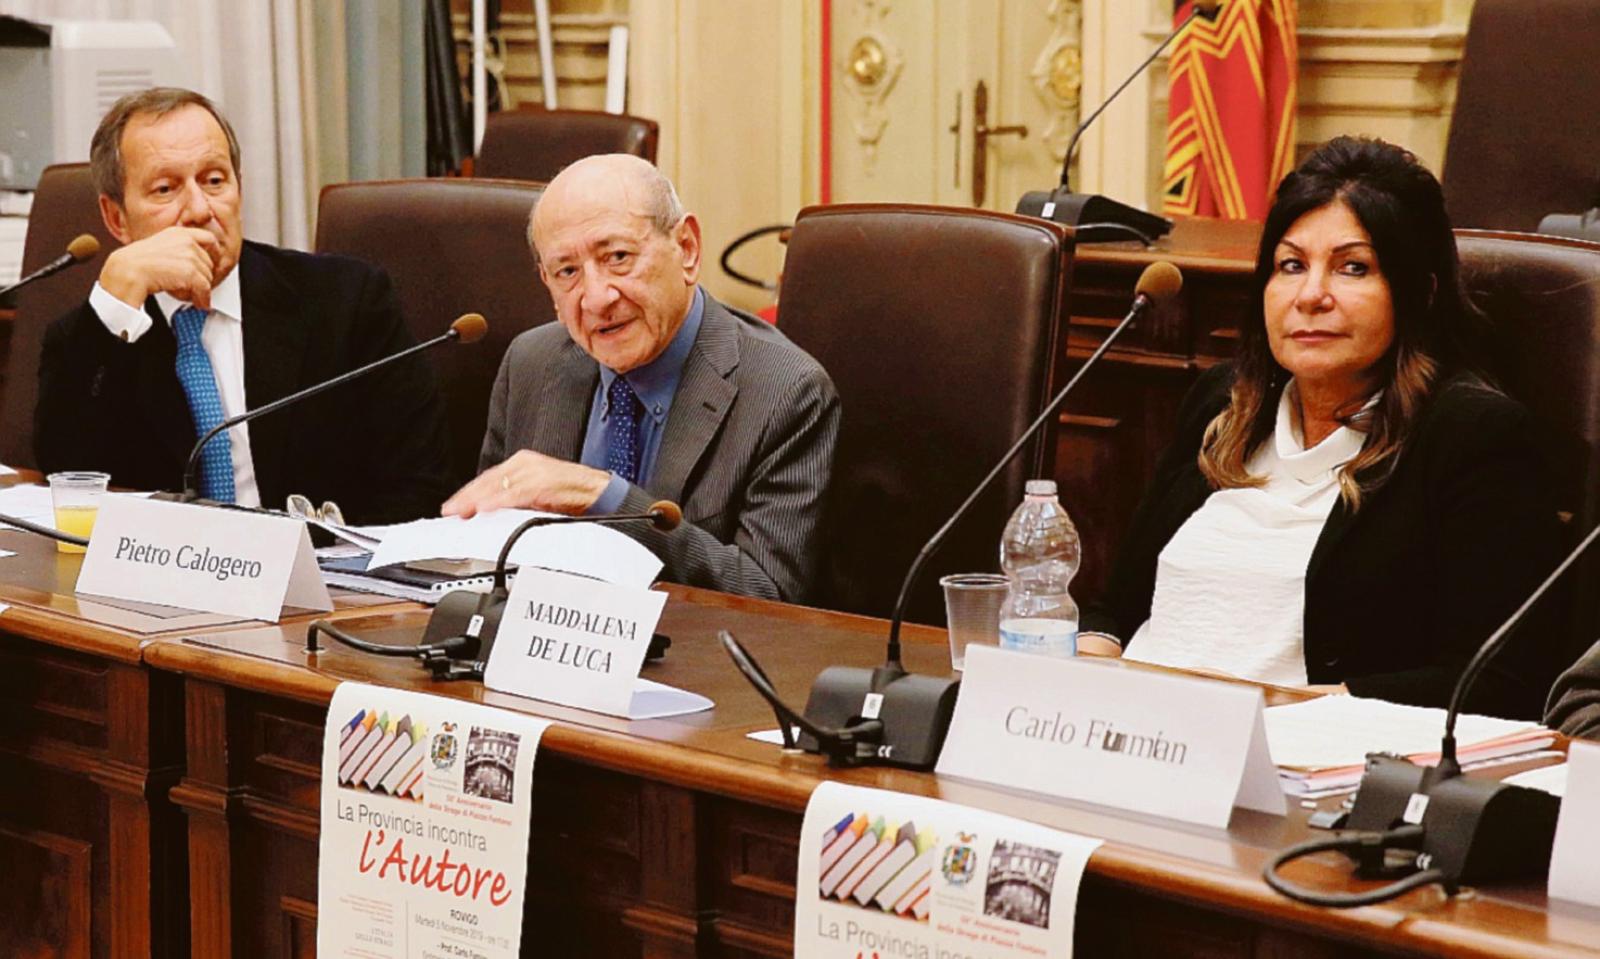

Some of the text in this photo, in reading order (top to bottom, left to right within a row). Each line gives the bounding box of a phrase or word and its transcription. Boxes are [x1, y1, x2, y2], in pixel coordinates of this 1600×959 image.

[114, 535, 263, 581] Pietro Calogero
[523, 600, 637, 641] MADDALENA
[526, 635, 613, 673] DE LUCA
[1004, 705, 1076, 745] Carlo
[337, 799, 488, 852] La Provincia incontra
[817, 913, 929, 959] La Provincia
